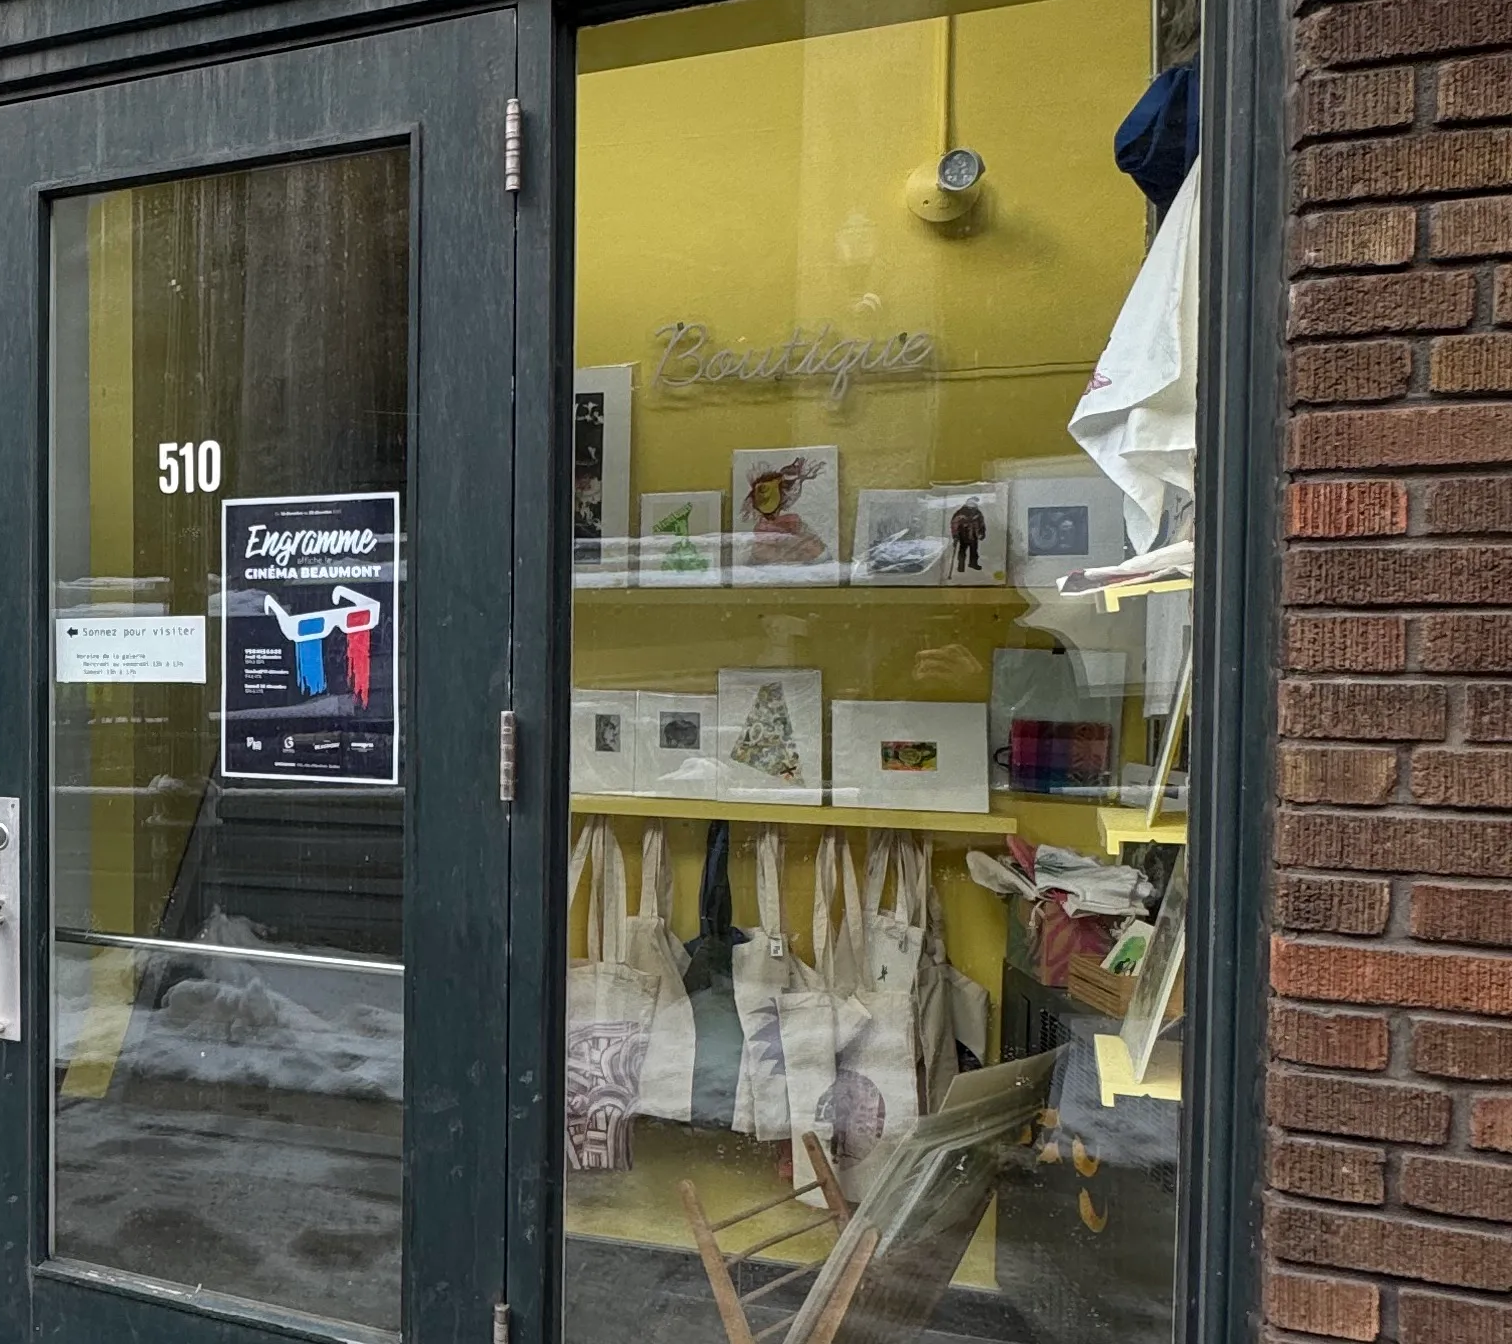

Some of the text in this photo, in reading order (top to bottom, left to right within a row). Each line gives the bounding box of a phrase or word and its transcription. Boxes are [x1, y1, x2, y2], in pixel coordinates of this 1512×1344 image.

[652, 322, 936, 400] Boutique
[158, 440, 222, 495] 510
[245, 523, 378, 567] Engramme
[244, 564, 382, 580] CINÉMA BEAUMONT
[82, 626, 196, 639] Sonnez pour visiter
